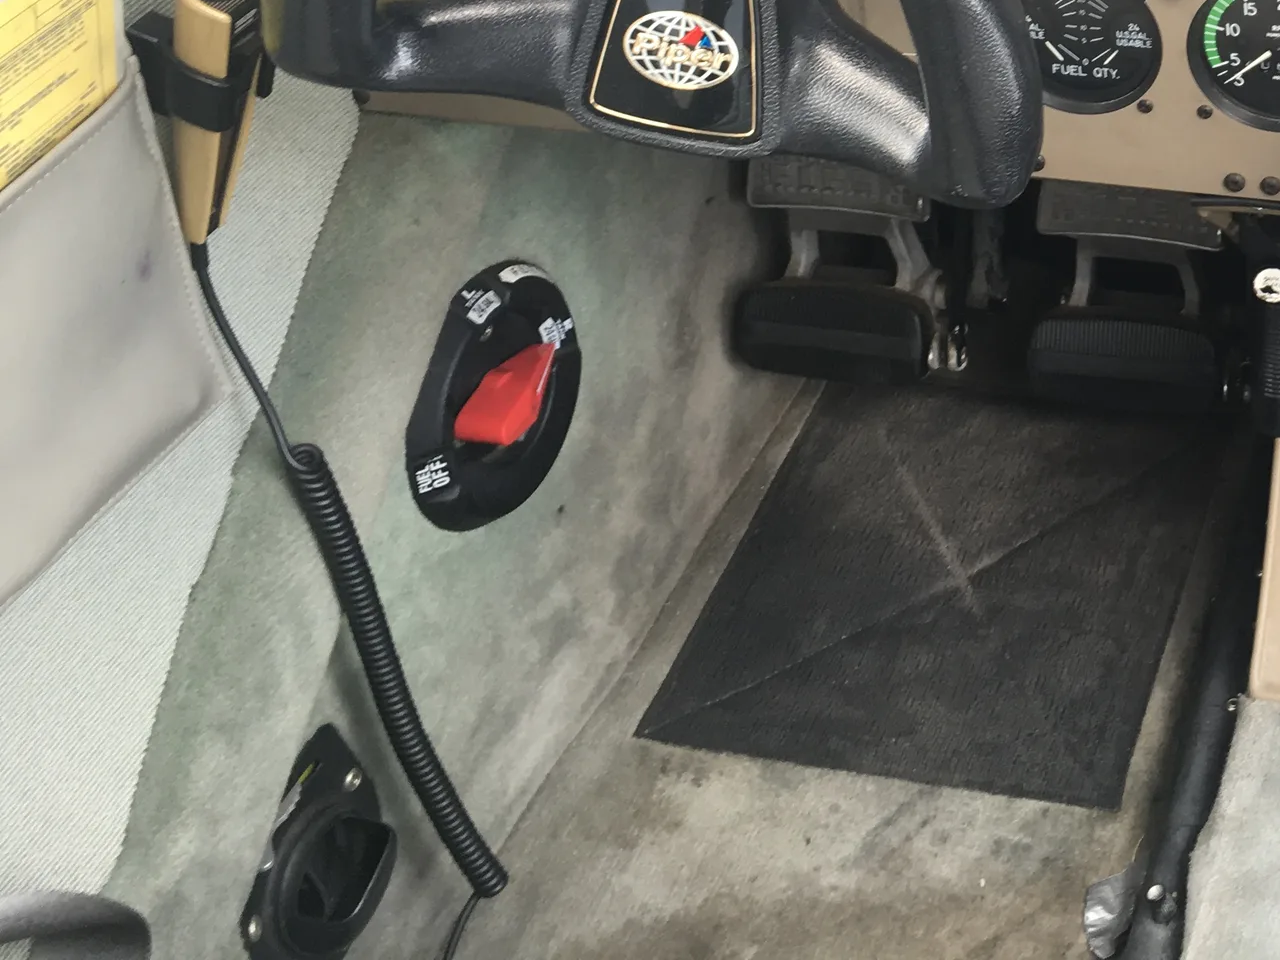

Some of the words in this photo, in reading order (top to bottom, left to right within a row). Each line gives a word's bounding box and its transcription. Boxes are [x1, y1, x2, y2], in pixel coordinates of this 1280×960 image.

[1243, 3, 1257, 16] 15
[1226, 23, 1240, 36] 10
[1116, 39, 1152, 48] USABLE
[1052, 64, 1087, 76] FUEL
[1093, 67, 1120, 79] QTY.
[416, 465, 431, 494] FUEL
[432, 456, 450, 489] OFF
